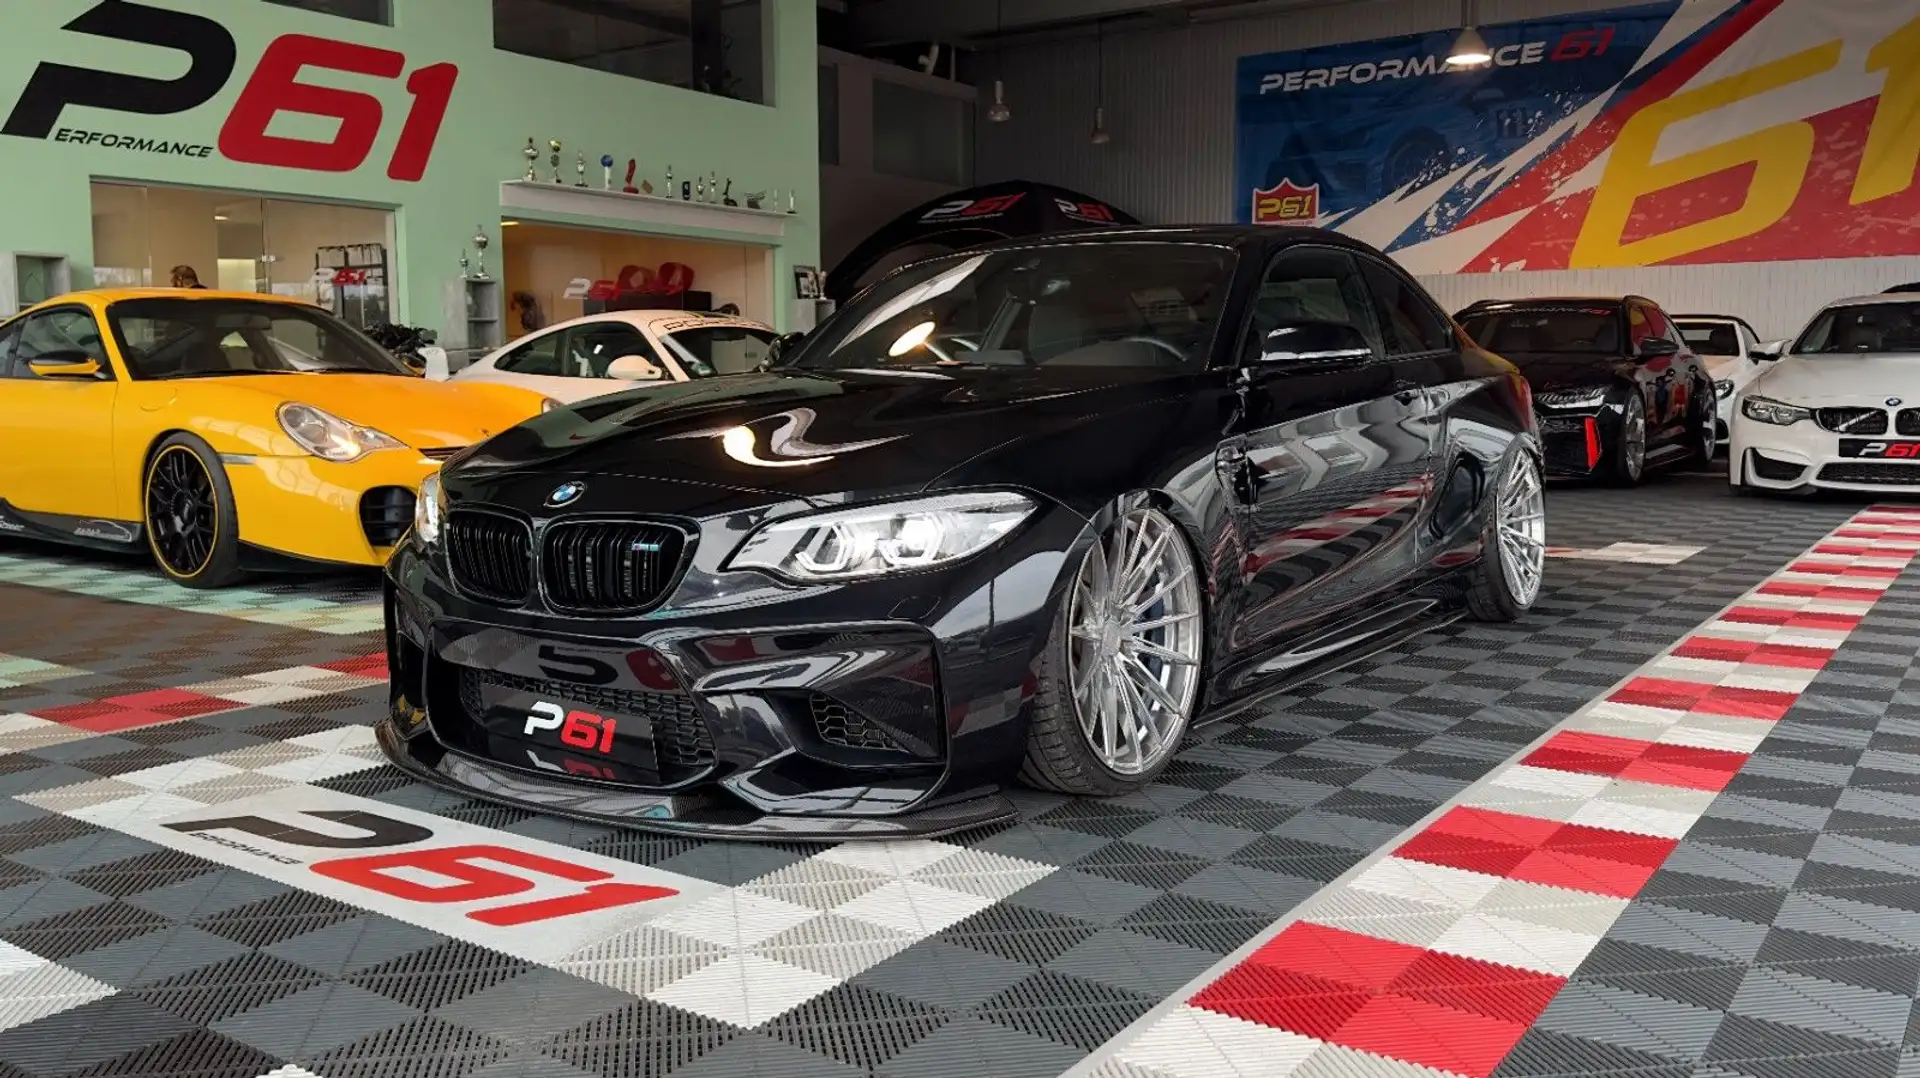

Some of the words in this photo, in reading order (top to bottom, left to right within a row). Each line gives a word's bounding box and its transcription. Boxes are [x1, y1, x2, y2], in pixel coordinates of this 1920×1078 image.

[1550, 24, 1617, 63] 61
[0, 0, 459, 183] P61
[1257, 194, 1313, 220] P61
[1858, 441, 1920, 458] P61
[523, 701, 617, 756] P61
[160, 809, 681, 927] P61
